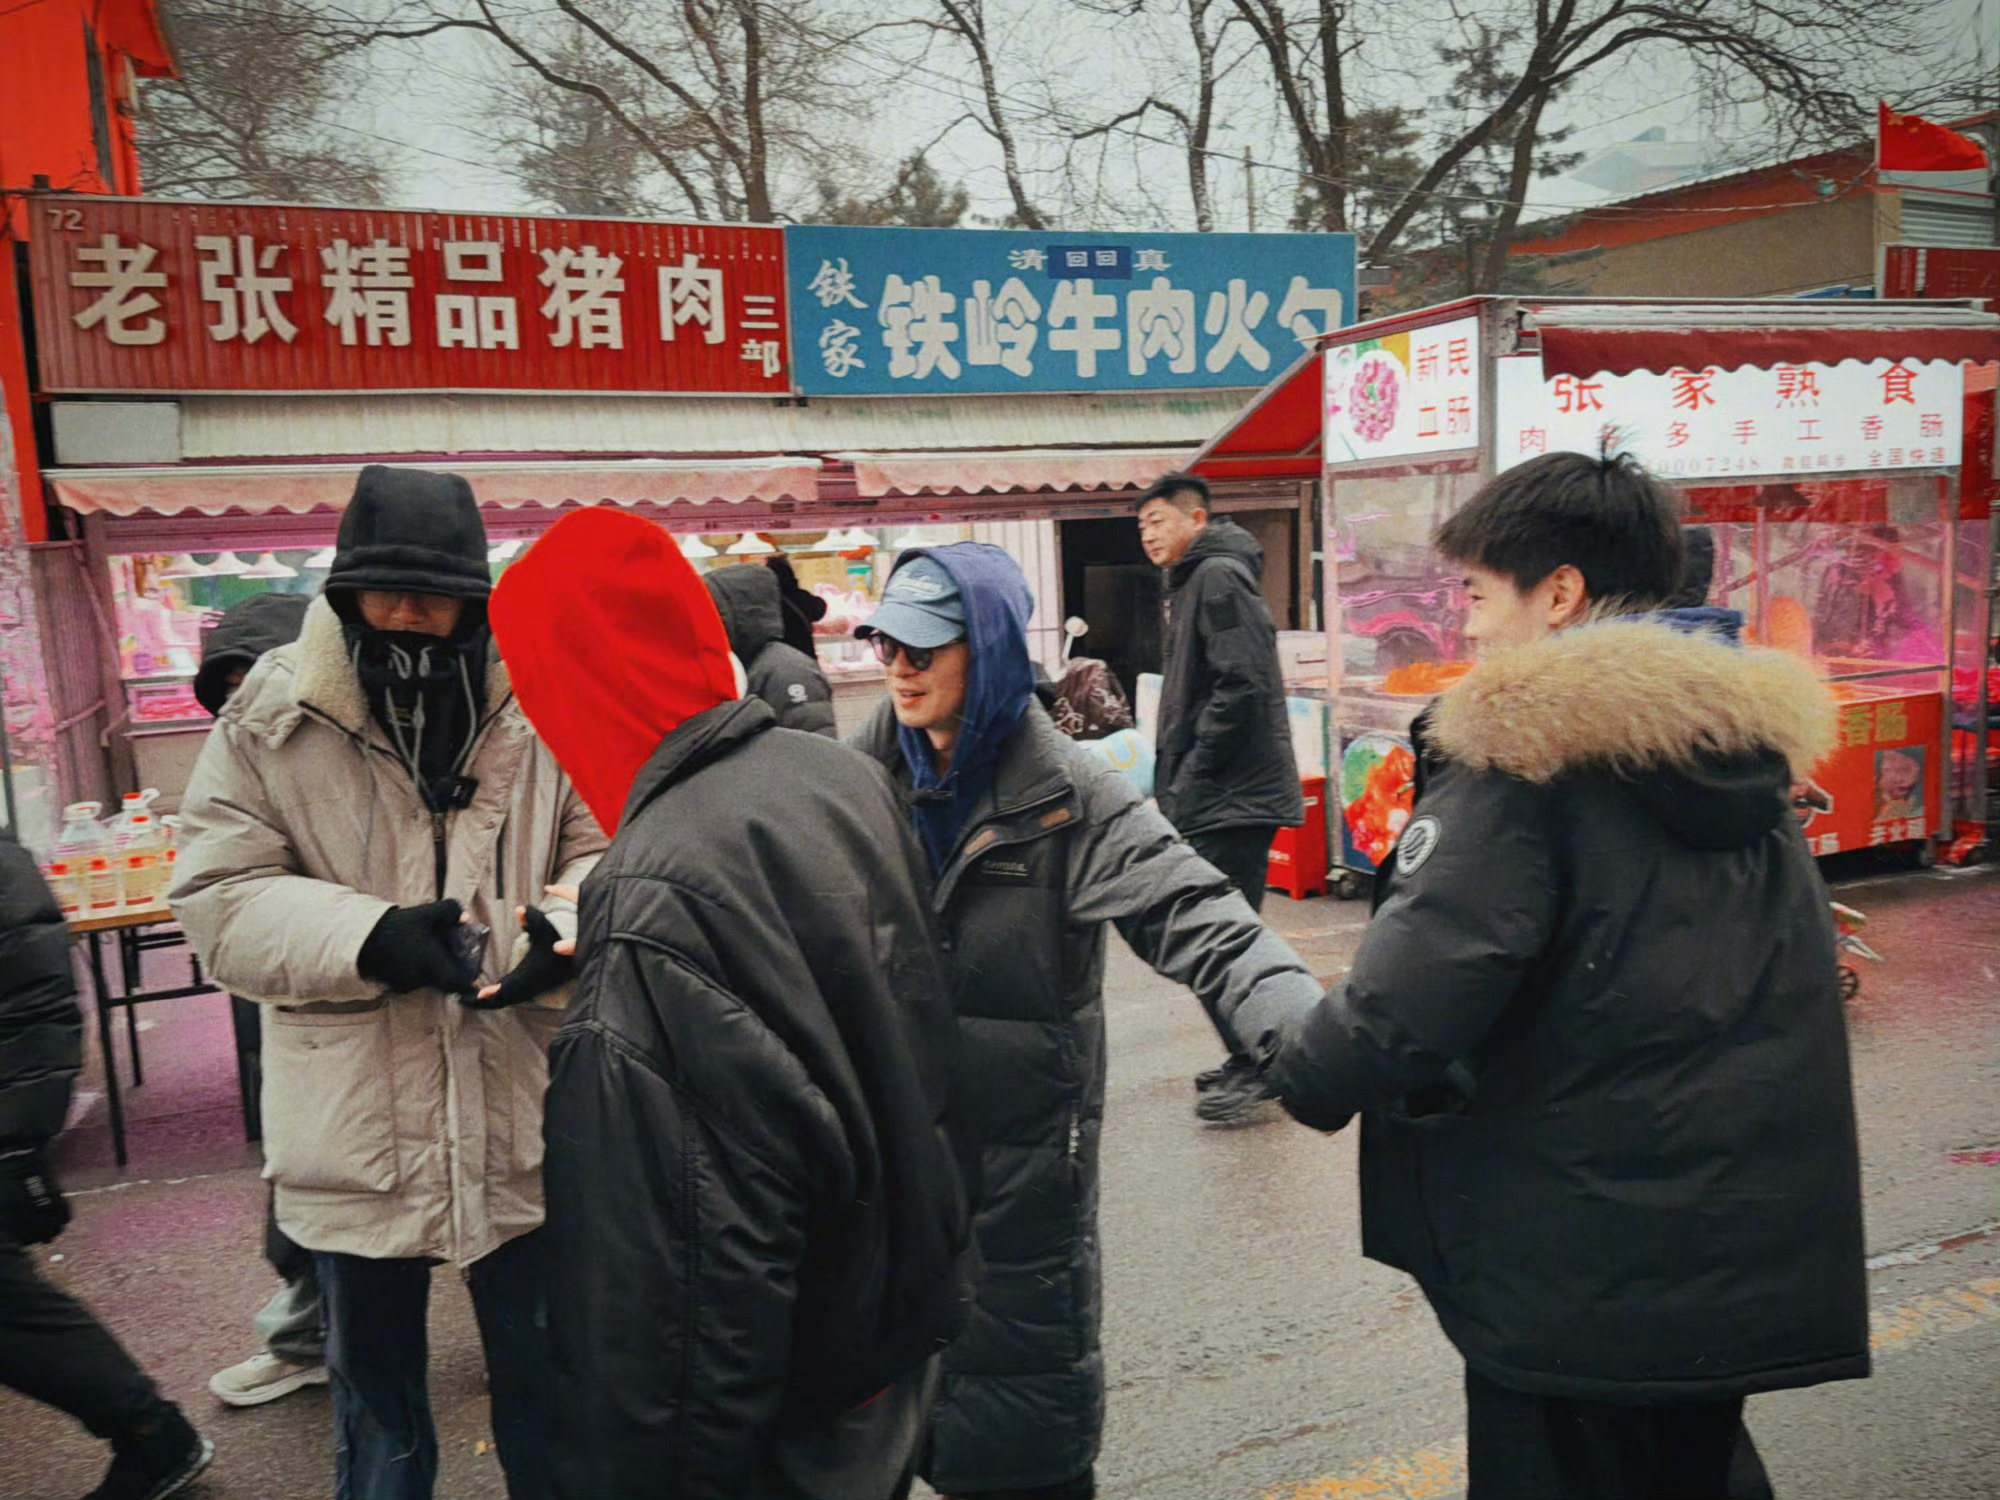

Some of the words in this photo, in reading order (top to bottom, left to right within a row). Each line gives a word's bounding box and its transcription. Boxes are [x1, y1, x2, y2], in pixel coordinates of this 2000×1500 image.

[48, 208, 84, 232] 72
[70, 233, 727, 351] 老张精品猪肉
[739, 295, 781, 378] 三部
[806, 257, 869, 378] 铁家
[877, 274, 1344, 381] 铁岭牛肉火勺
[1552, 362, 1919, 414] 张家熟食
